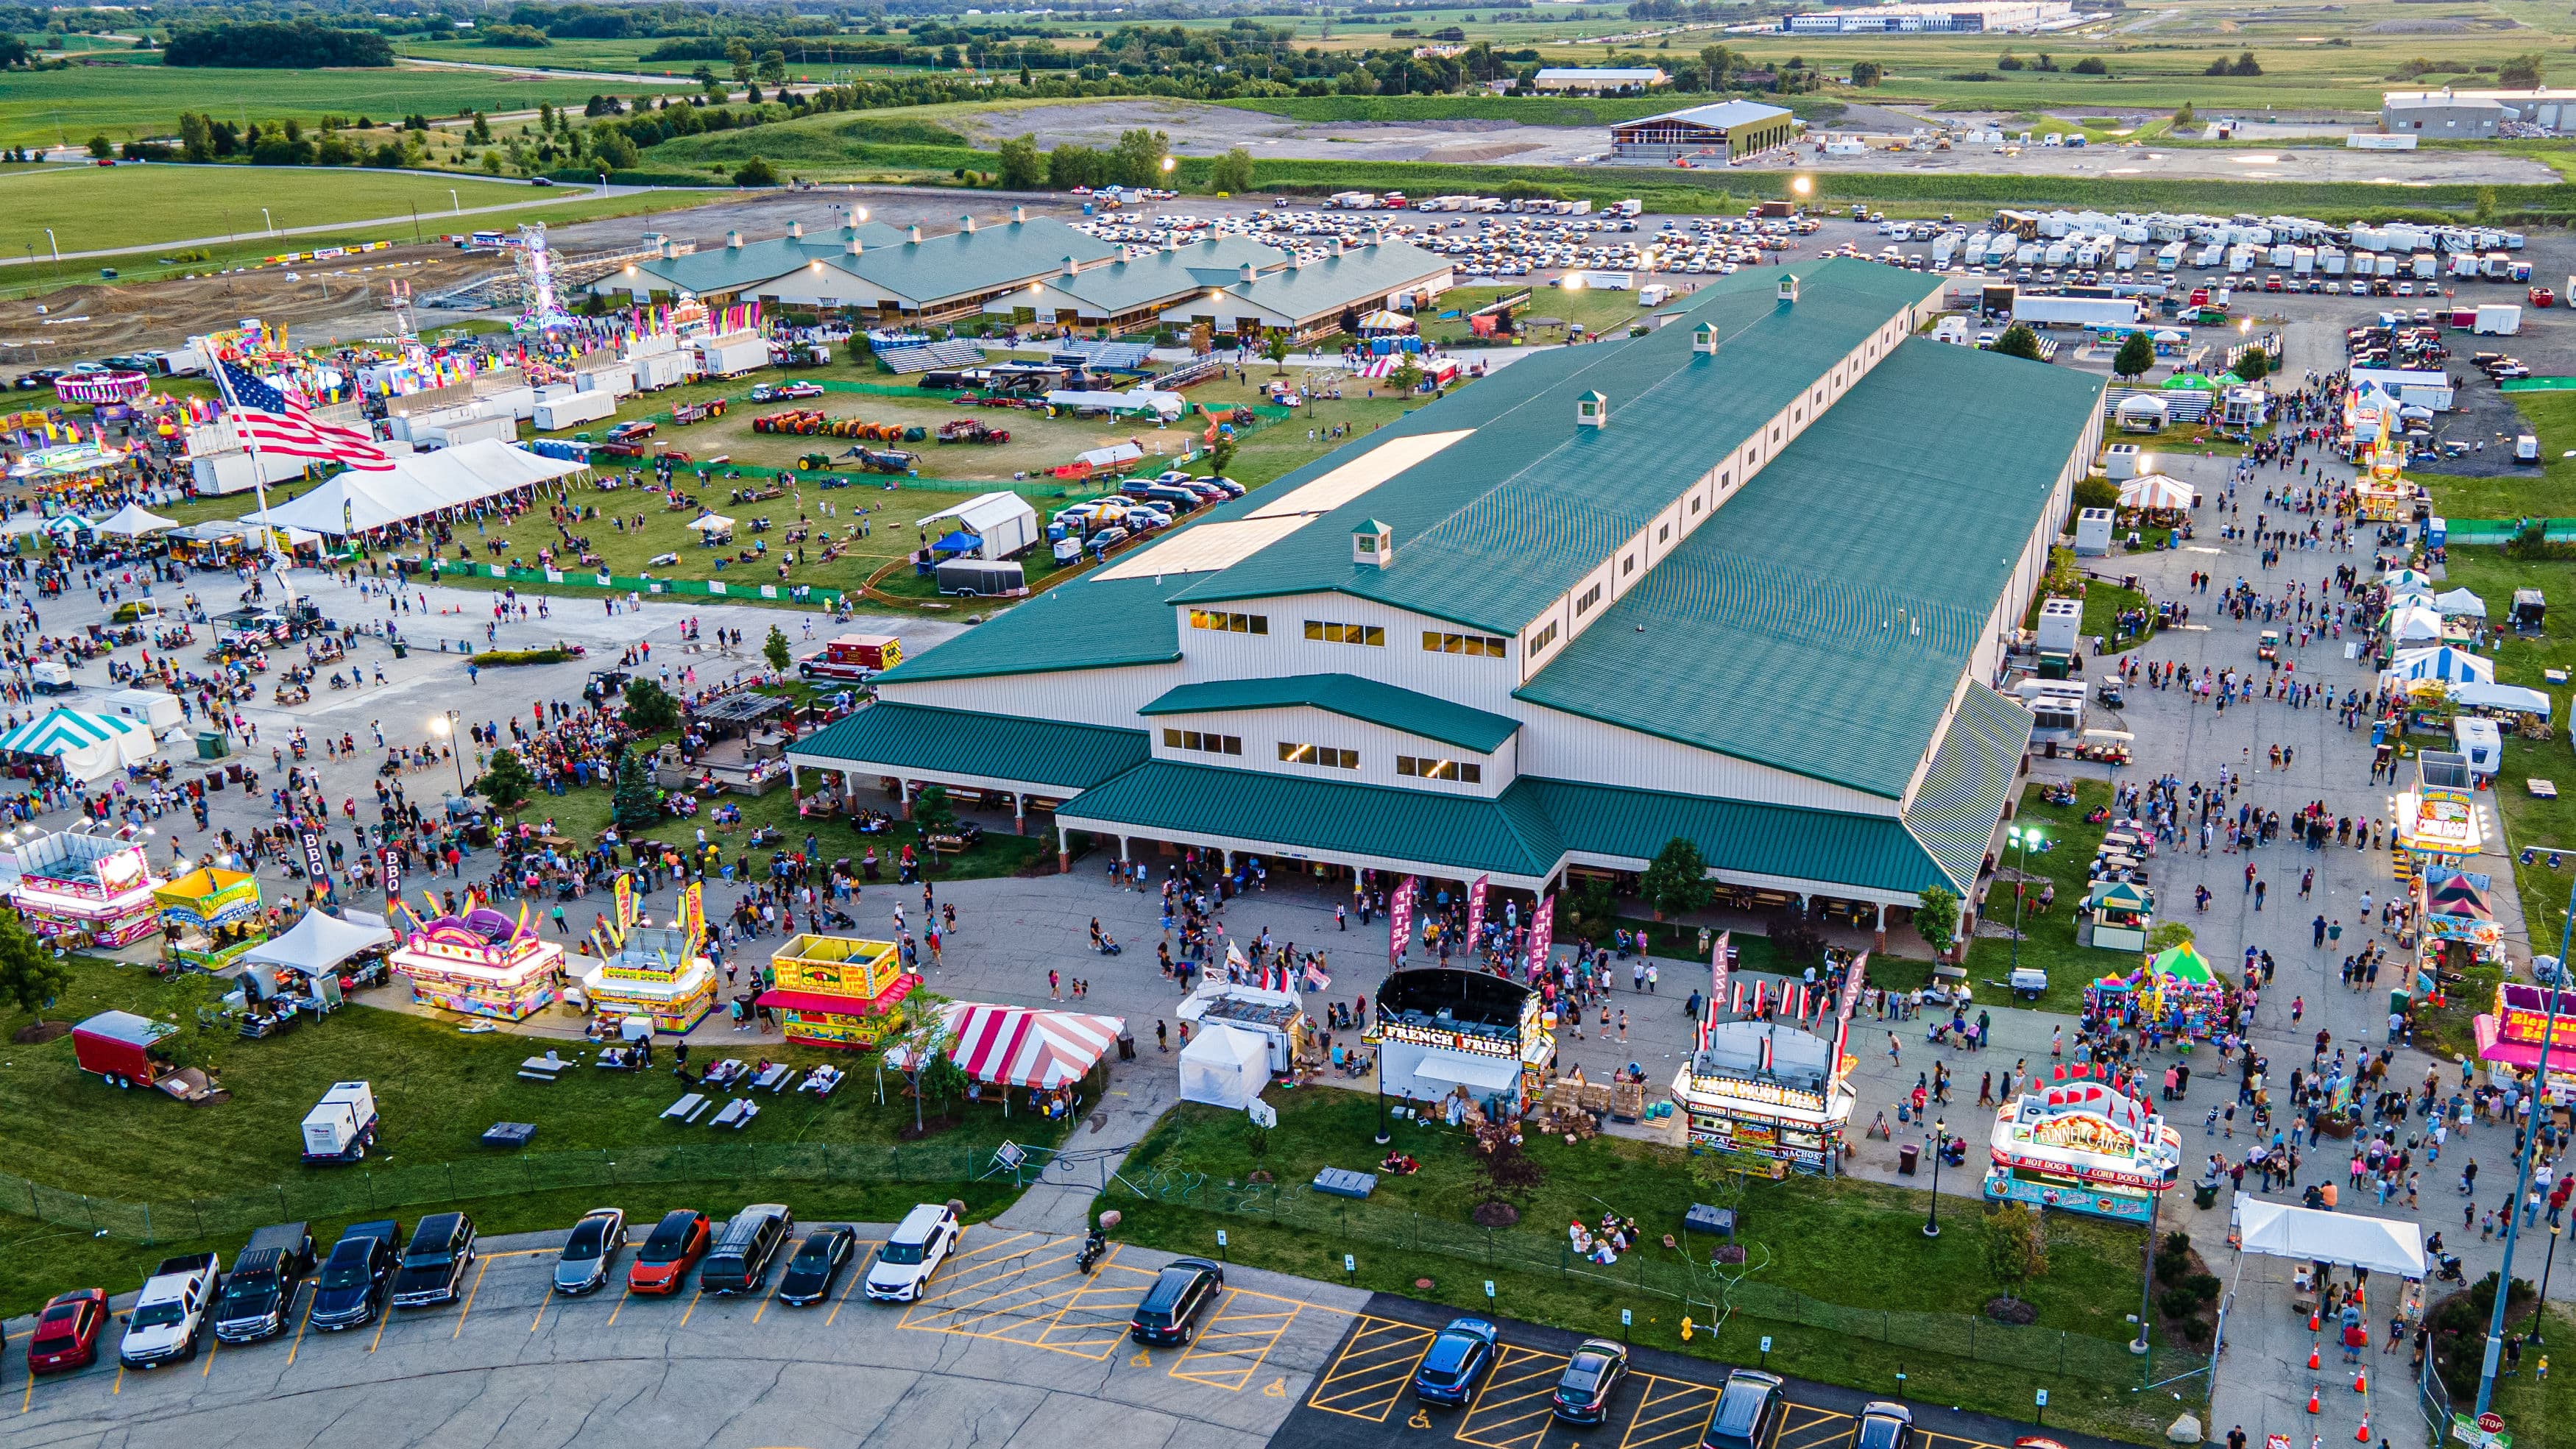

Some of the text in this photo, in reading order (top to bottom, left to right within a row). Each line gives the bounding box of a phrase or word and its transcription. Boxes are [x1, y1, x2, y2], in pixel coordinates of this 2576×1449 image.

[303, 834, 325, 875] BBQ
[386, 851, 400, 891] BBQ
[607, 970, 670, 982] CORN DOGS
[802, 966, 838, 978] WISCONSIN
[802, 977, 841, 988] Cheese
[600, 990, 626, 998] JUMBO
[2510, 1012, 2576, 1033] Elephan
[1385, 1025, 1512, 1055] FRENCH FRIES
[2522, 1026, 2560, 1041] Eas
[1695, 1077, 1819, 1109] FRESH DOUGH PIZZA
[1688, 1103, 1727, 1116] CALZONES
[1731, 1110, 1758, 1121] MEATBALL
[1780, 1117, 1816, 1131] PASTA
[2039, 1126, 2130, 1155] FUNNEL CAKES
[1781, 1149, 1822, 1161] NACHOS!
[2025, 1158, 2067, 1172] HOT DOGS
[2091, 1169, 2140, 1183] CORN DOGS
[2457, 1420, 2480, 1434] VENDO
[2479, 1417, 2503, 1429] STOP
